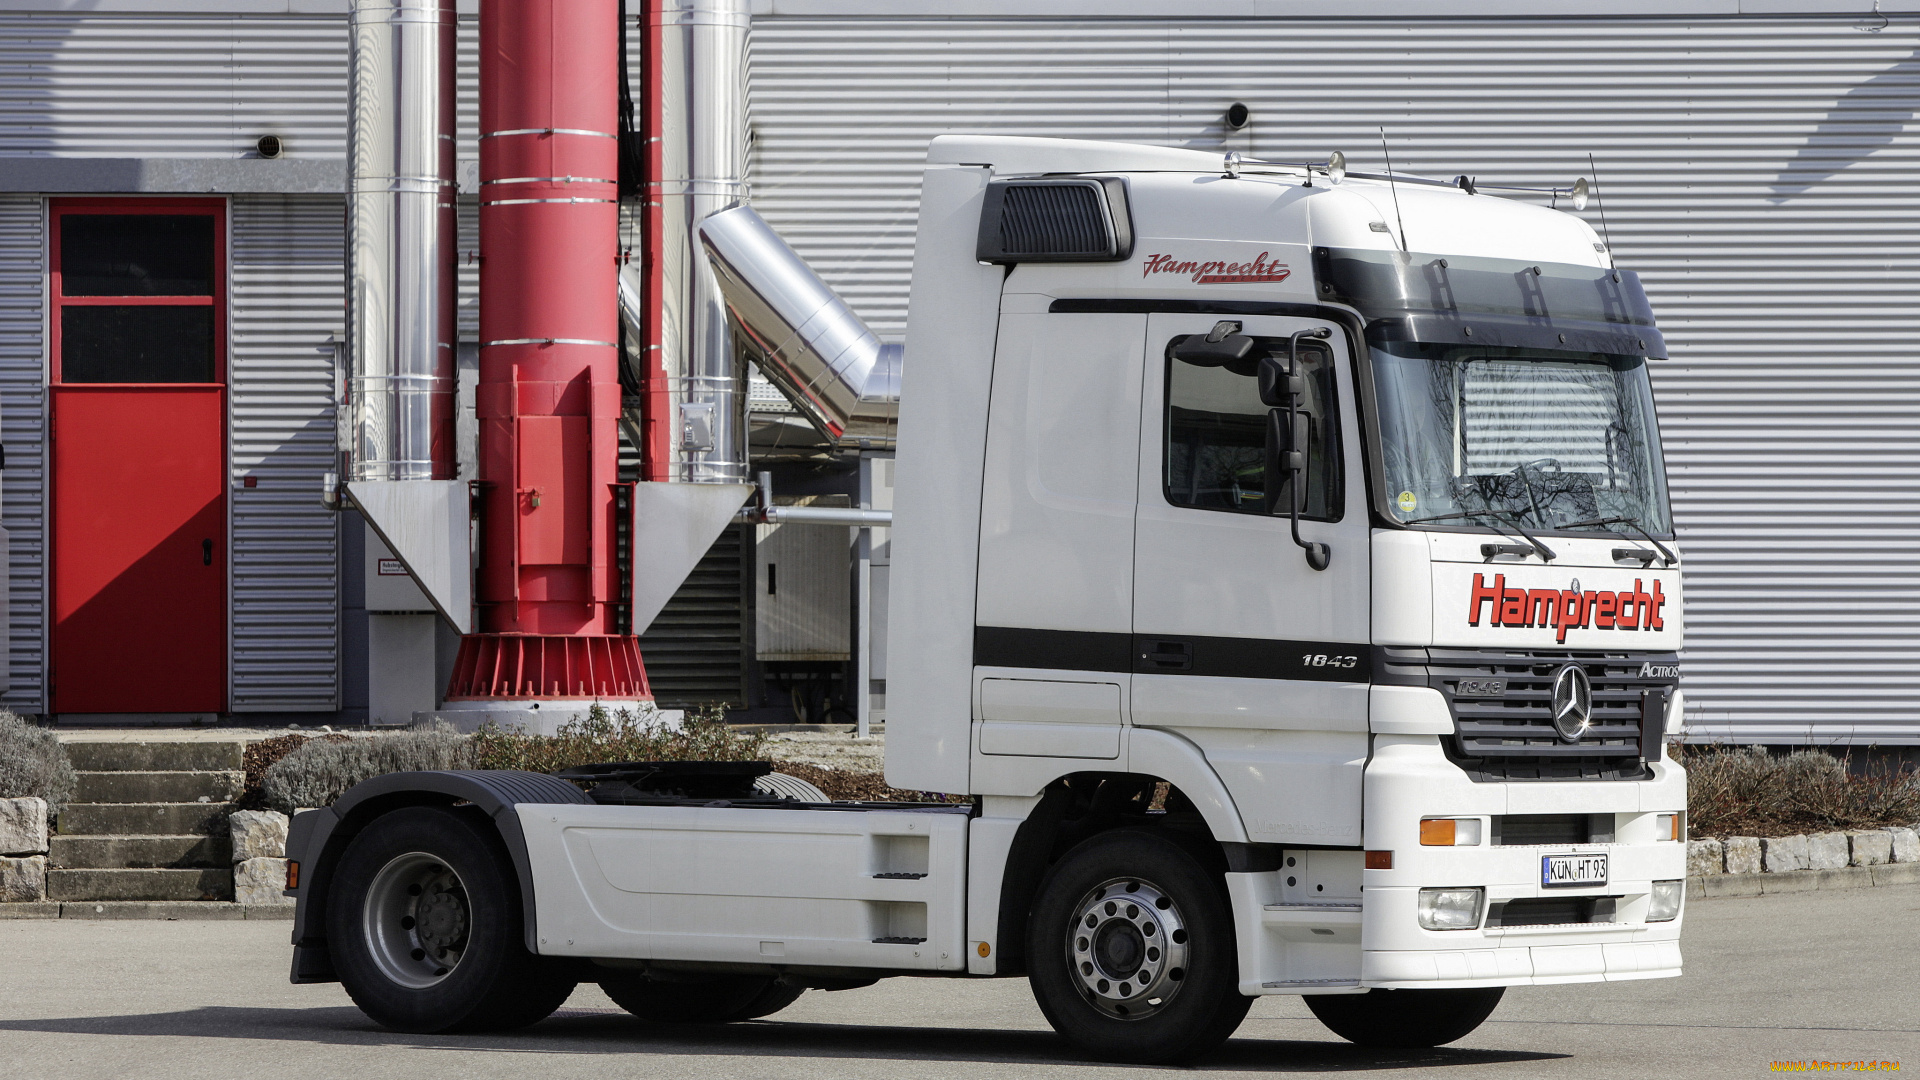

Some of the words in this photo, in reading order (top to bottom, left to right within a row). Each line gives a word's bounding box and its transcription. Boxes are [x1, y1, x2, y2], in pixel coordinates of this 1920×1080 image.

[1143, 251, 1290, 283] Hamprecht
[1404, 492, 1410, 502] 3
[1468, 573, 1665, 644] Hamprecht
[1302, 654, 1358, 668] 1843
[1638, 661, 1679, 679] ACTROS
[1459, 680, 1501, 696] 1843
[1255, 818, 1353, 837] Mercedes-Benz
[1578, 859, 1591, 879] HT
[1593, 859, 1606, 879] 93
